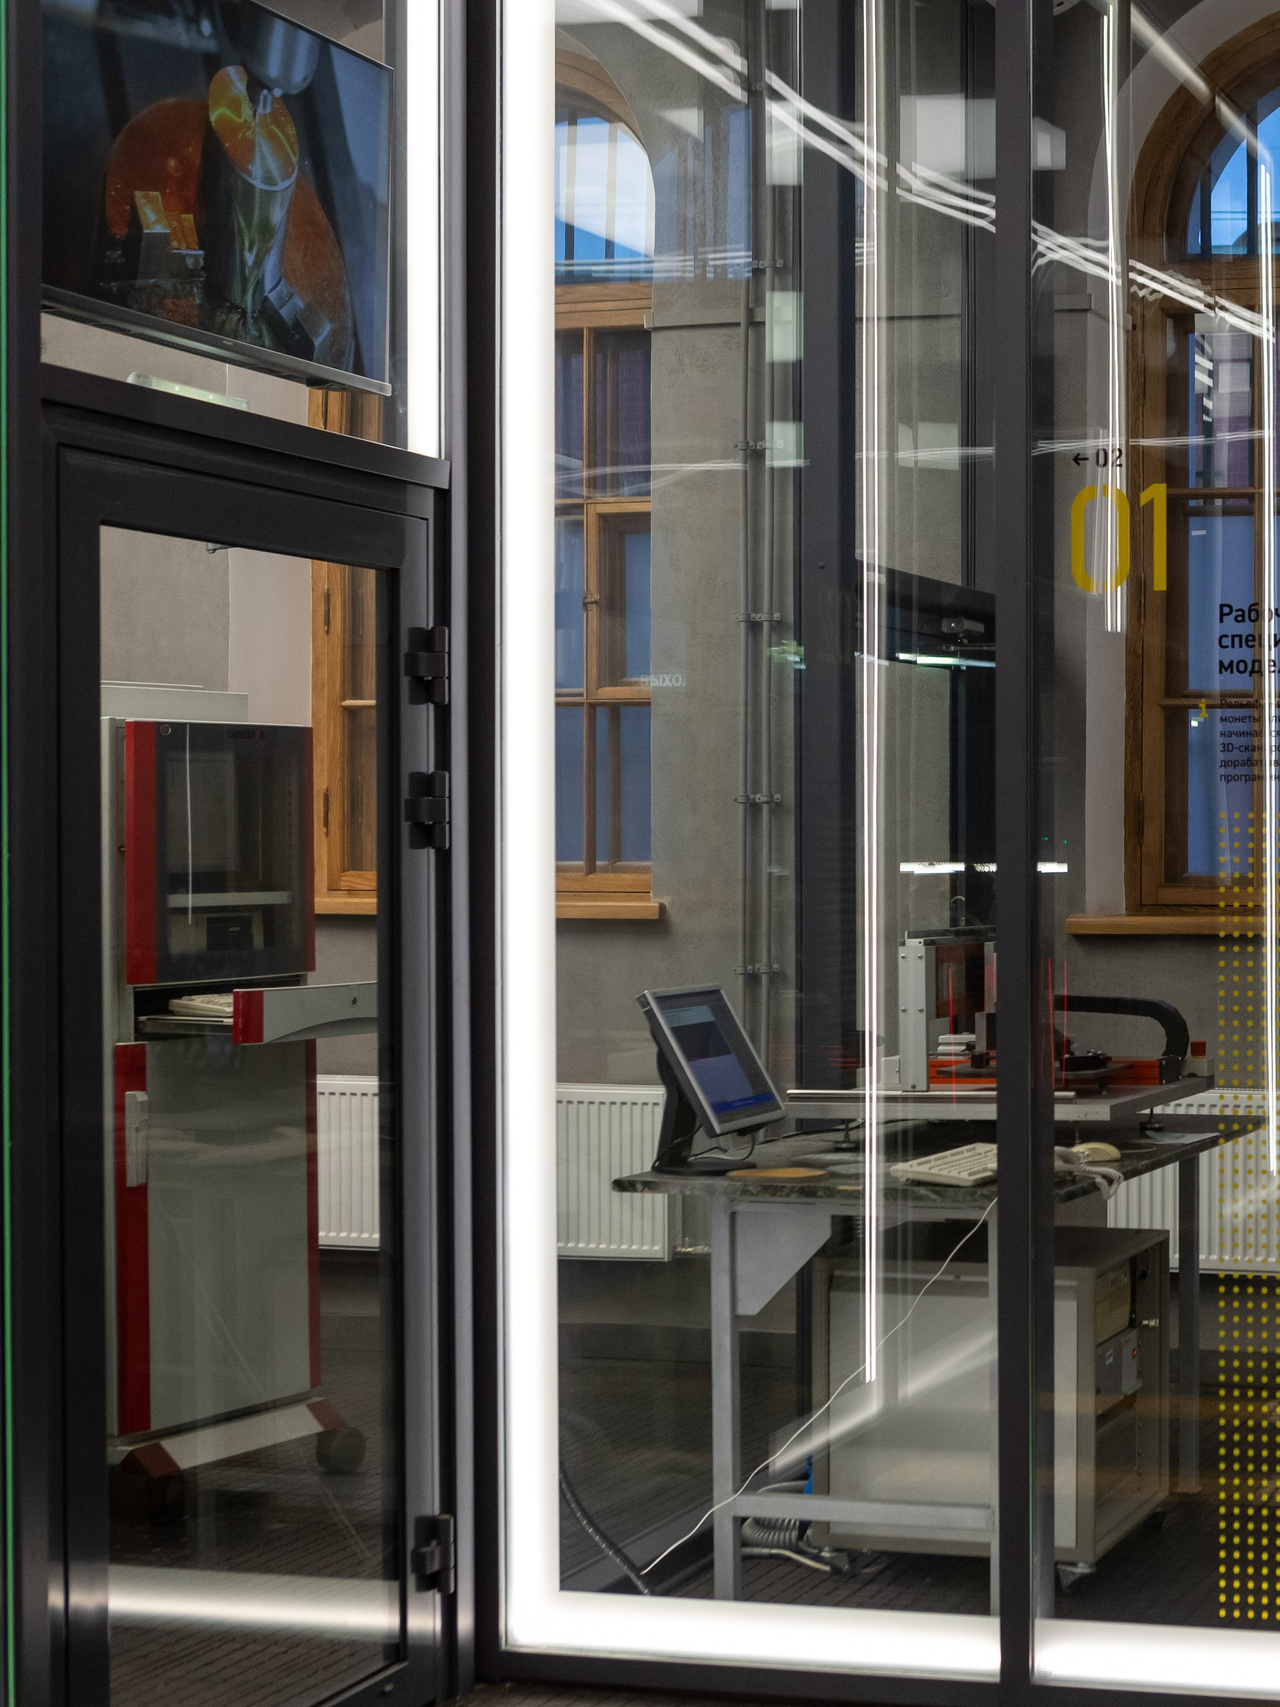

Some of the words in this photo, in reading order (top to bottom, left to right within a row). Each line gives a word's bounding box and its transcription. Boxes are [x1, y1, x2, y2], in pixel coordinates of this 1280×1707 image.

[1096, 448, 1123, 467] 02
[1071, 483, 1167, 592] 01
[1220, 698, 1261, 710] Рельеф
[1220, 715, 1260, 723] монеты
